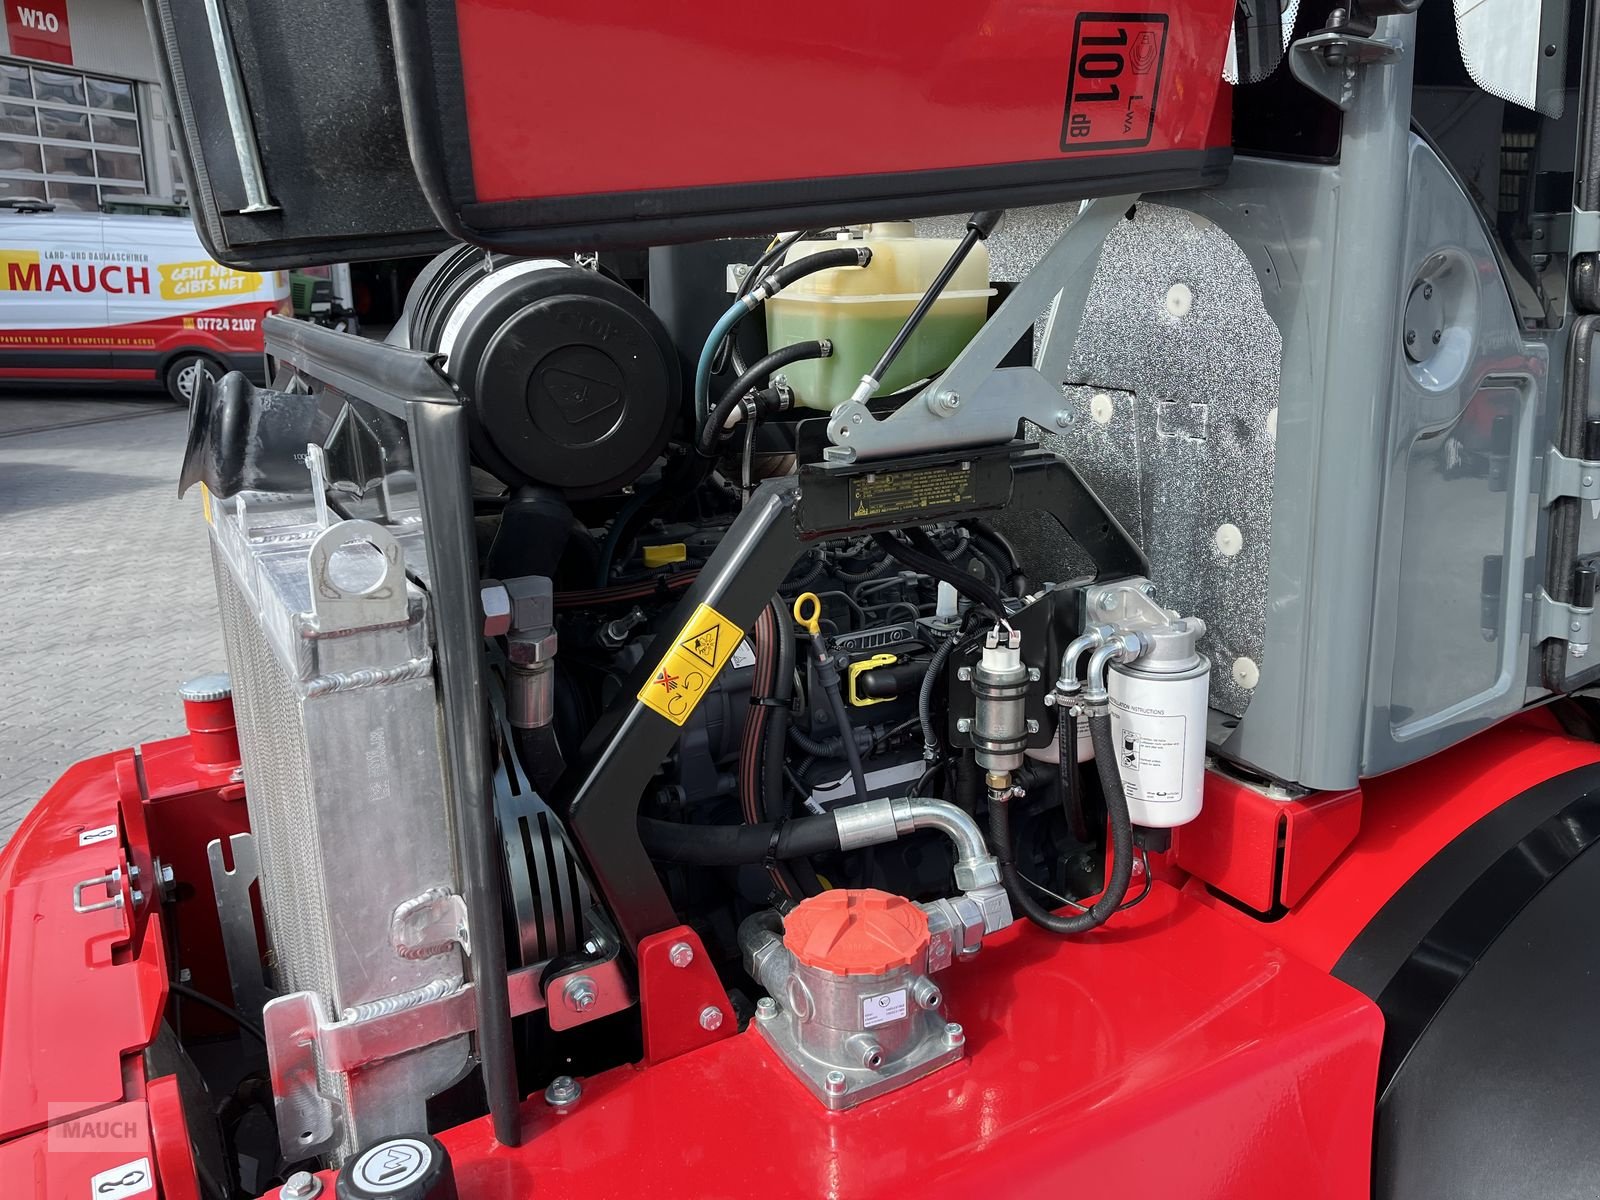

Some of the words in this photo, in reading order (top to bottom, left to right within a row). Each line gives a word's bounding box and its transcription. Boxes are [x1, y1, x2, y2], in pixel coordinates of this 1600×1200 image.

[17, 6, 59, 33] W10
[1075, 28, 1128, 103] 101
[1070, 113, 1092, 138] dB
[71, 251, 86, 260] UND
[88, 252, 149, 262] BAUMASCHINEN
[8, 263, 150, 294] MAUCH
[171, 266, 206, 280] GEHT
[174, 279, 216, 295] GIBTS
[219, 276, 246, 290] NET
[196, 317, 230, 331] 07724
[232, 318, 256, 331] 2107
